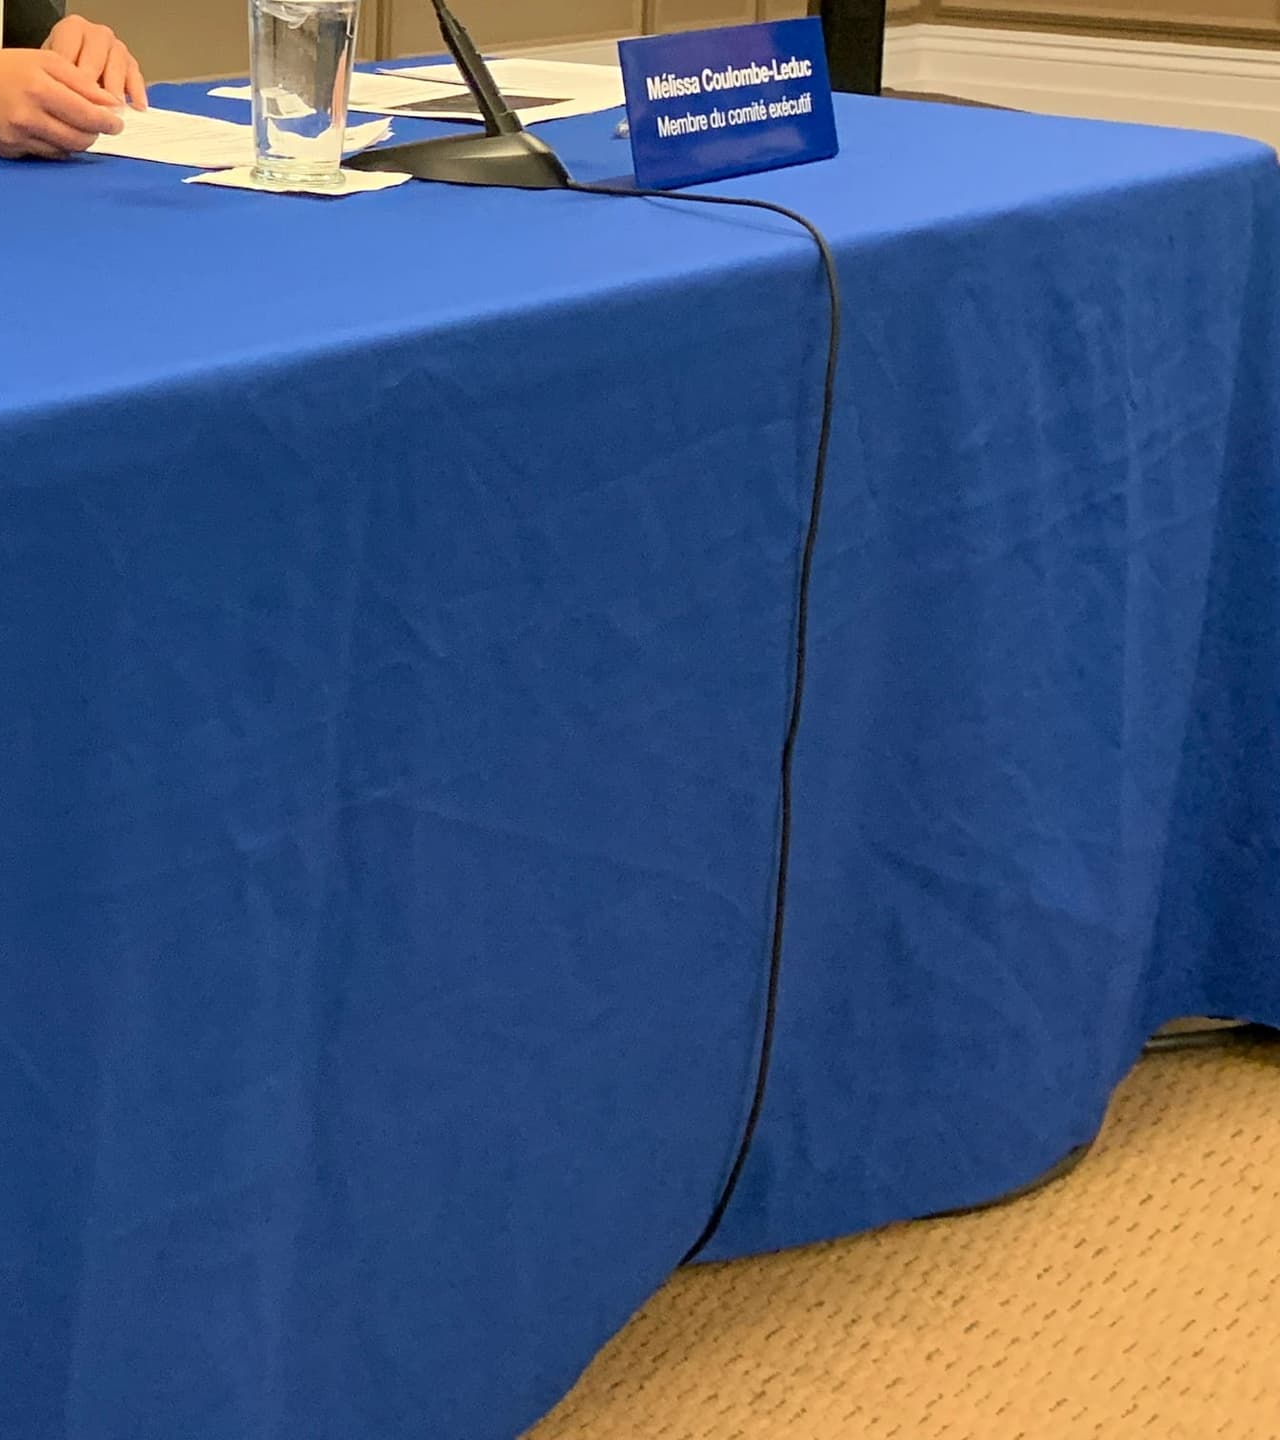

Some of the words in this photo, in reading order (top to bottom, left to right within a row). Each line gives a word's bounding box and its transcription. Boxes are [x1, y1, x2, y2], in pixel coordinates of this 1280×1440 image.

[646, 72, 701, 101] Mélissa
[701, 56, 813, 92] Coulombe-Leduc
[657, 110, 709, 138] Membre
[710, 107, 727, 129] du
[727, 99, 768, 126] comité
[769, 92, 813, 119] exécutif
